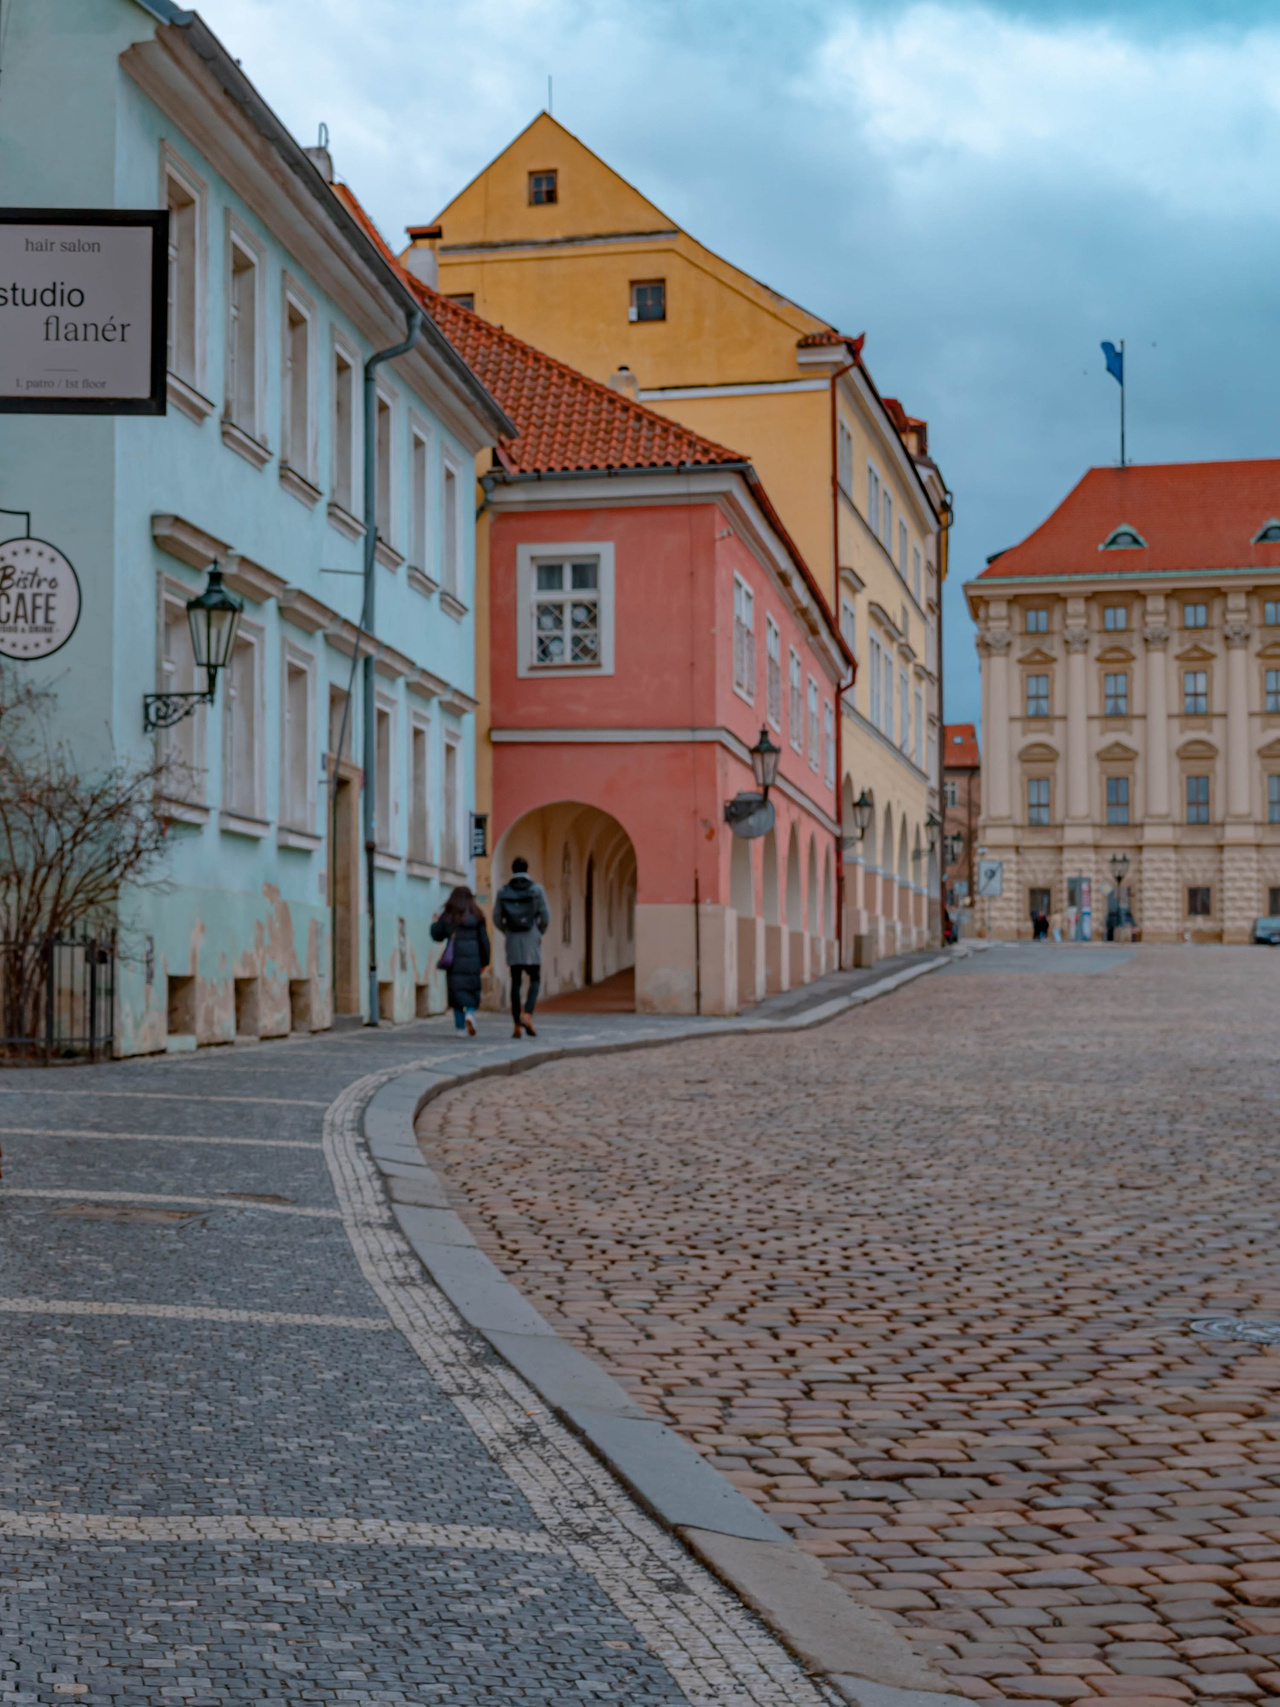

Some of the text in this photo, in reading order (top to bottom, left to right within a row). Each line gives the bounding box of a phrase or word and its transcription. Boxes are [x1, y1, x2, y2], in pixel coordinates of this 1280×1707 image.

[24, 238, 101, 253] hair salon
[43, 315, 131, 342] flanér
[26, 379, 55, 390] patro
[65, 379, 79, 389] 1st
[82, 378, 107, 389] floor
